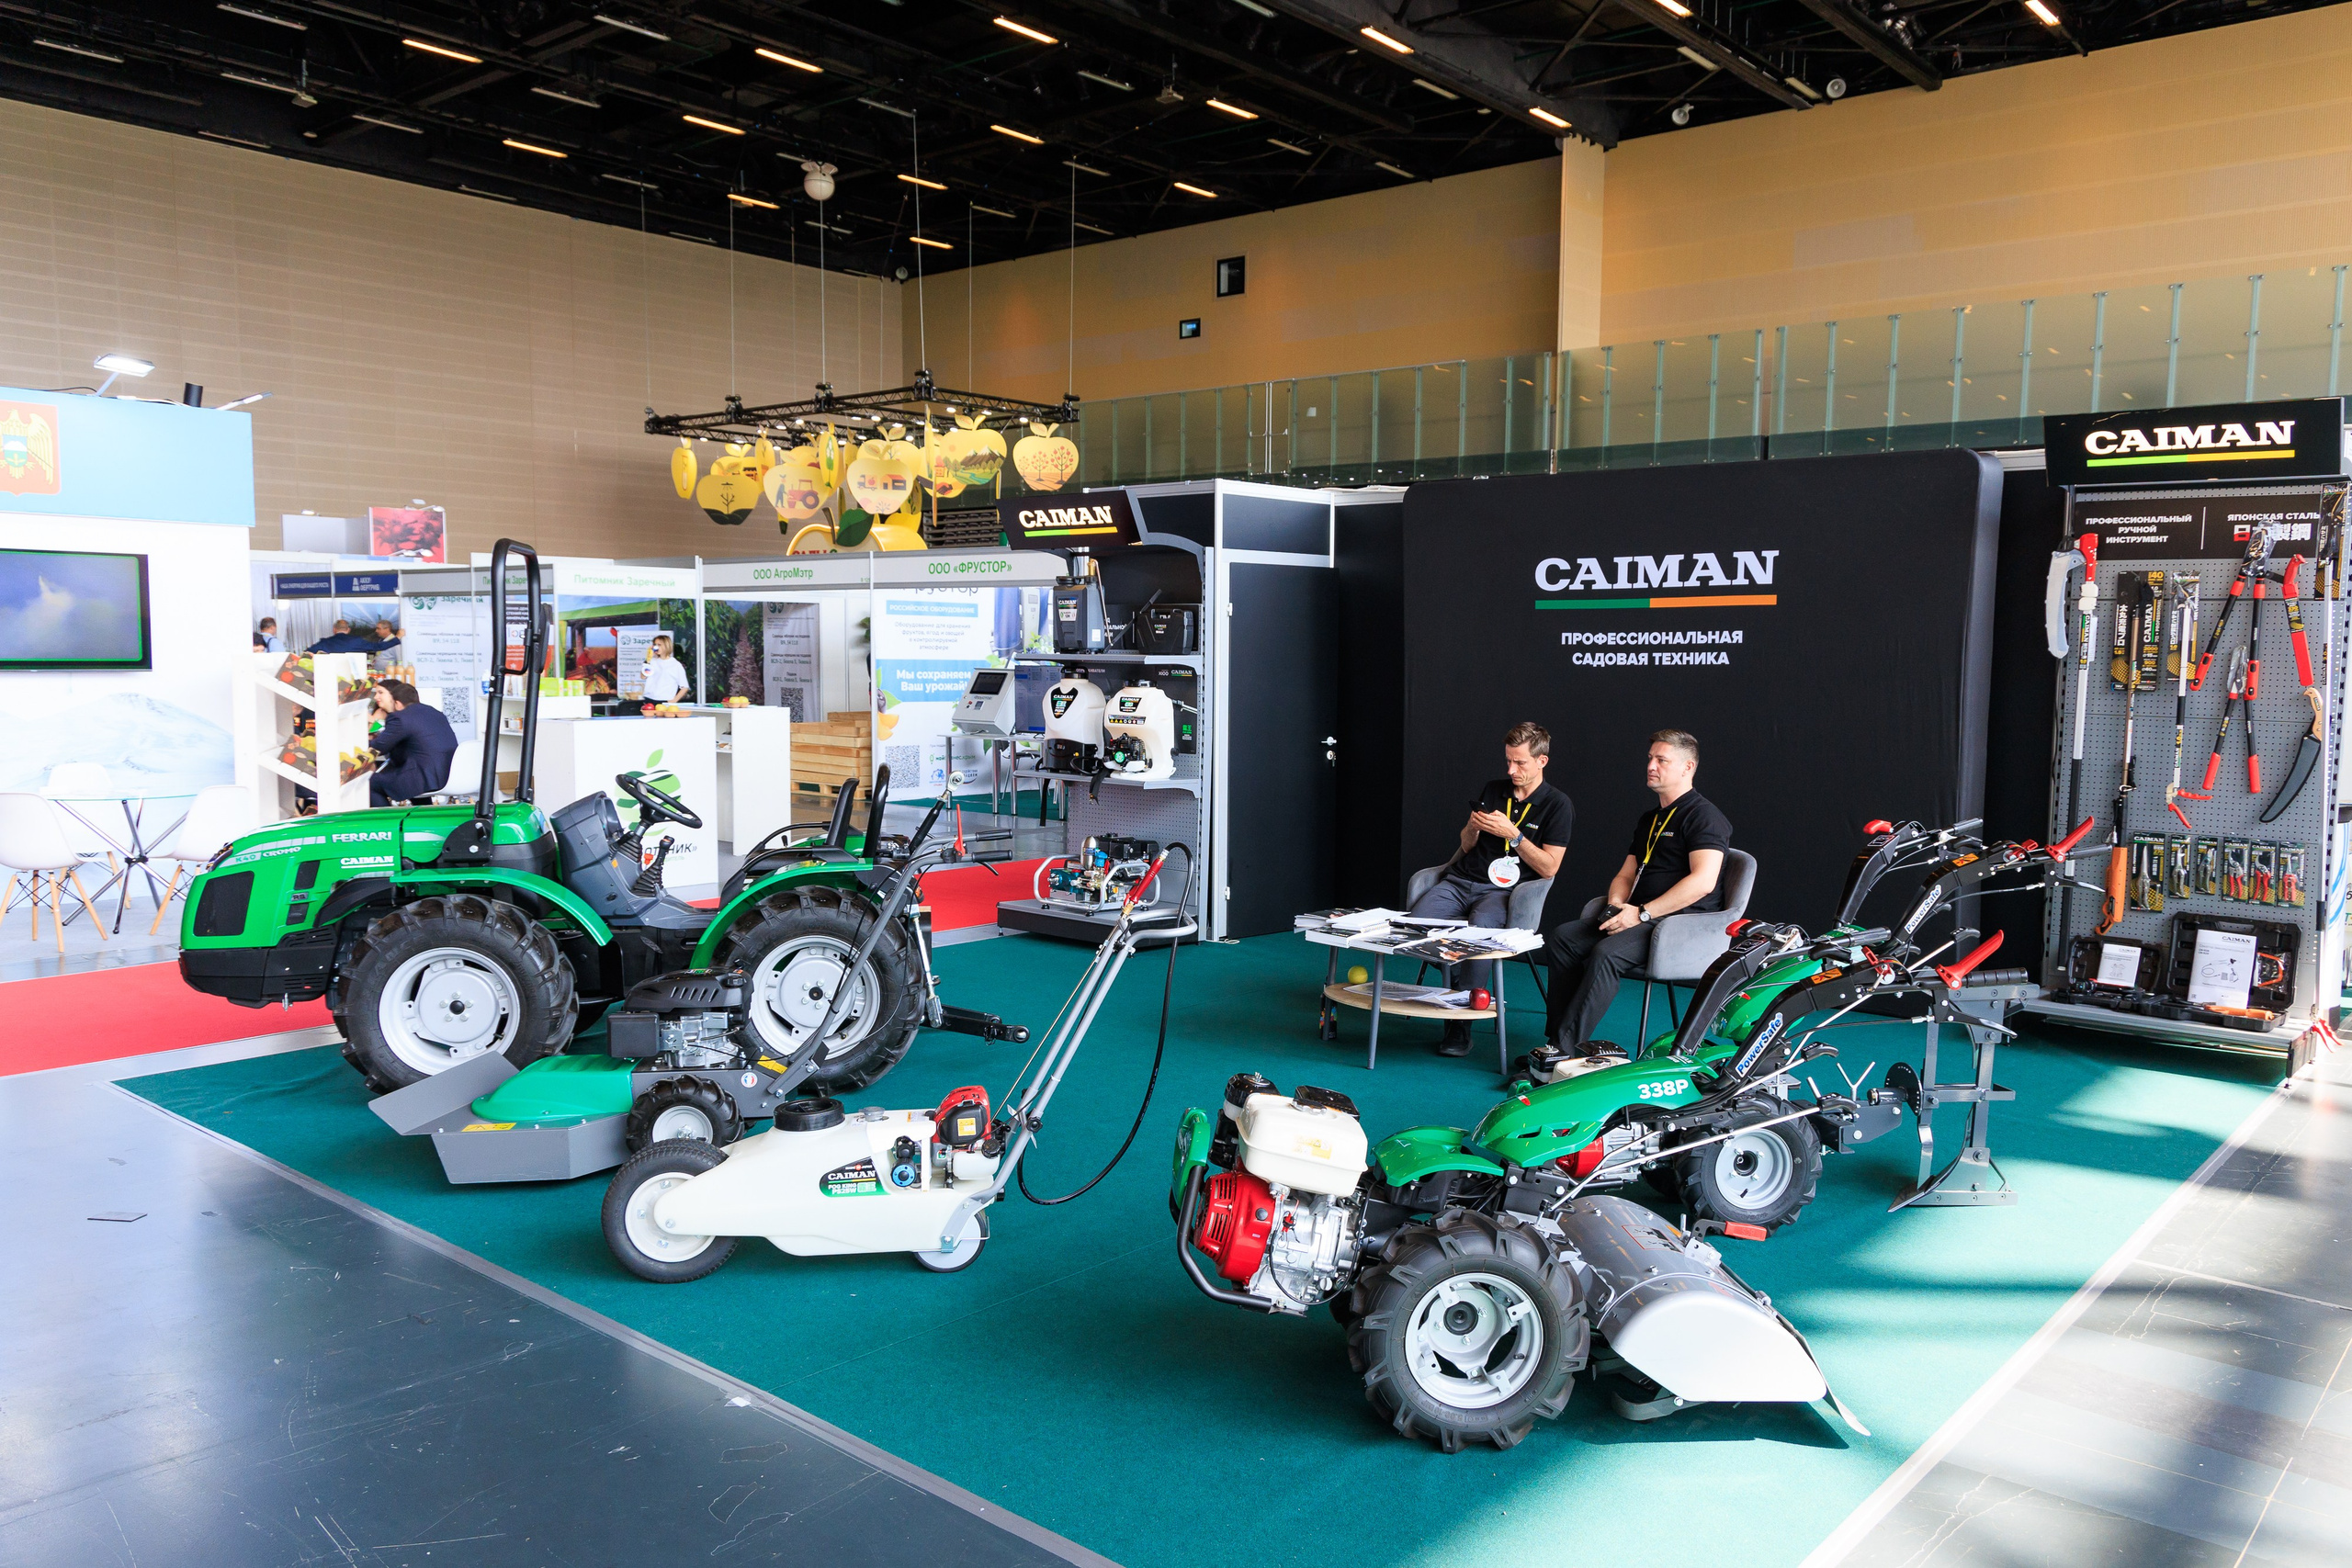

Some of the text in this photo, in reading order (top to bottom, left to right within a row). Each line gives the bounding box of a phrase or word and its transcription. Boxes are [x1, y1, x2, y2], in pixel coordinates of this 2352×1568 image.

[2085, 420, 2295, 456] CAIMAN
[1019, 505, 1113, 529] CAIMAN
[2086, 513, 2193, 525] ПРОФЕССИОНАЛЬНЫЙ
[2227, 512, 2321, 522] ЯПОНСКАЯ СТАЛЬ
[2118, 525, 2157, 534] РУЧНОЙ
[2106, 535, 2169, 544] ИНСТРУМЕНТ
[928, 560, 1012, 575] ООО «ФРУСТОР»
[1534, 549, 1780, 592] CAIMAN
[753, 567, 814, 581] ООО АгроМэтр
[574, 575, 675, 588] Питомник Заречный
[1561, 630, 1743, 646] ПРОФЕССИОНАЛЬНАЯ
[1572, 651, 1730, 667] САДОВАЯ ТЕХНИКА
[897, 670, 971, 682] Мы сохраняем
[900, 682, 923, 692] Ваш
[332, 831, 392, 843] FERRARI
[262, 846, 301, 858] CROMO
[235, 854, 256, 863] K40
[340, 855, 394, 865] CAIMAN
[1906, 887, 1940, 933] PowerSafe
[2222, 935, 2252, 943] CAIMAN
[1737, 1017, 1782, 1076] PowerSafe
[1637, 1078, 1689, 1100] 338P
[828, 1170, 876, 1180] CAIMAN
